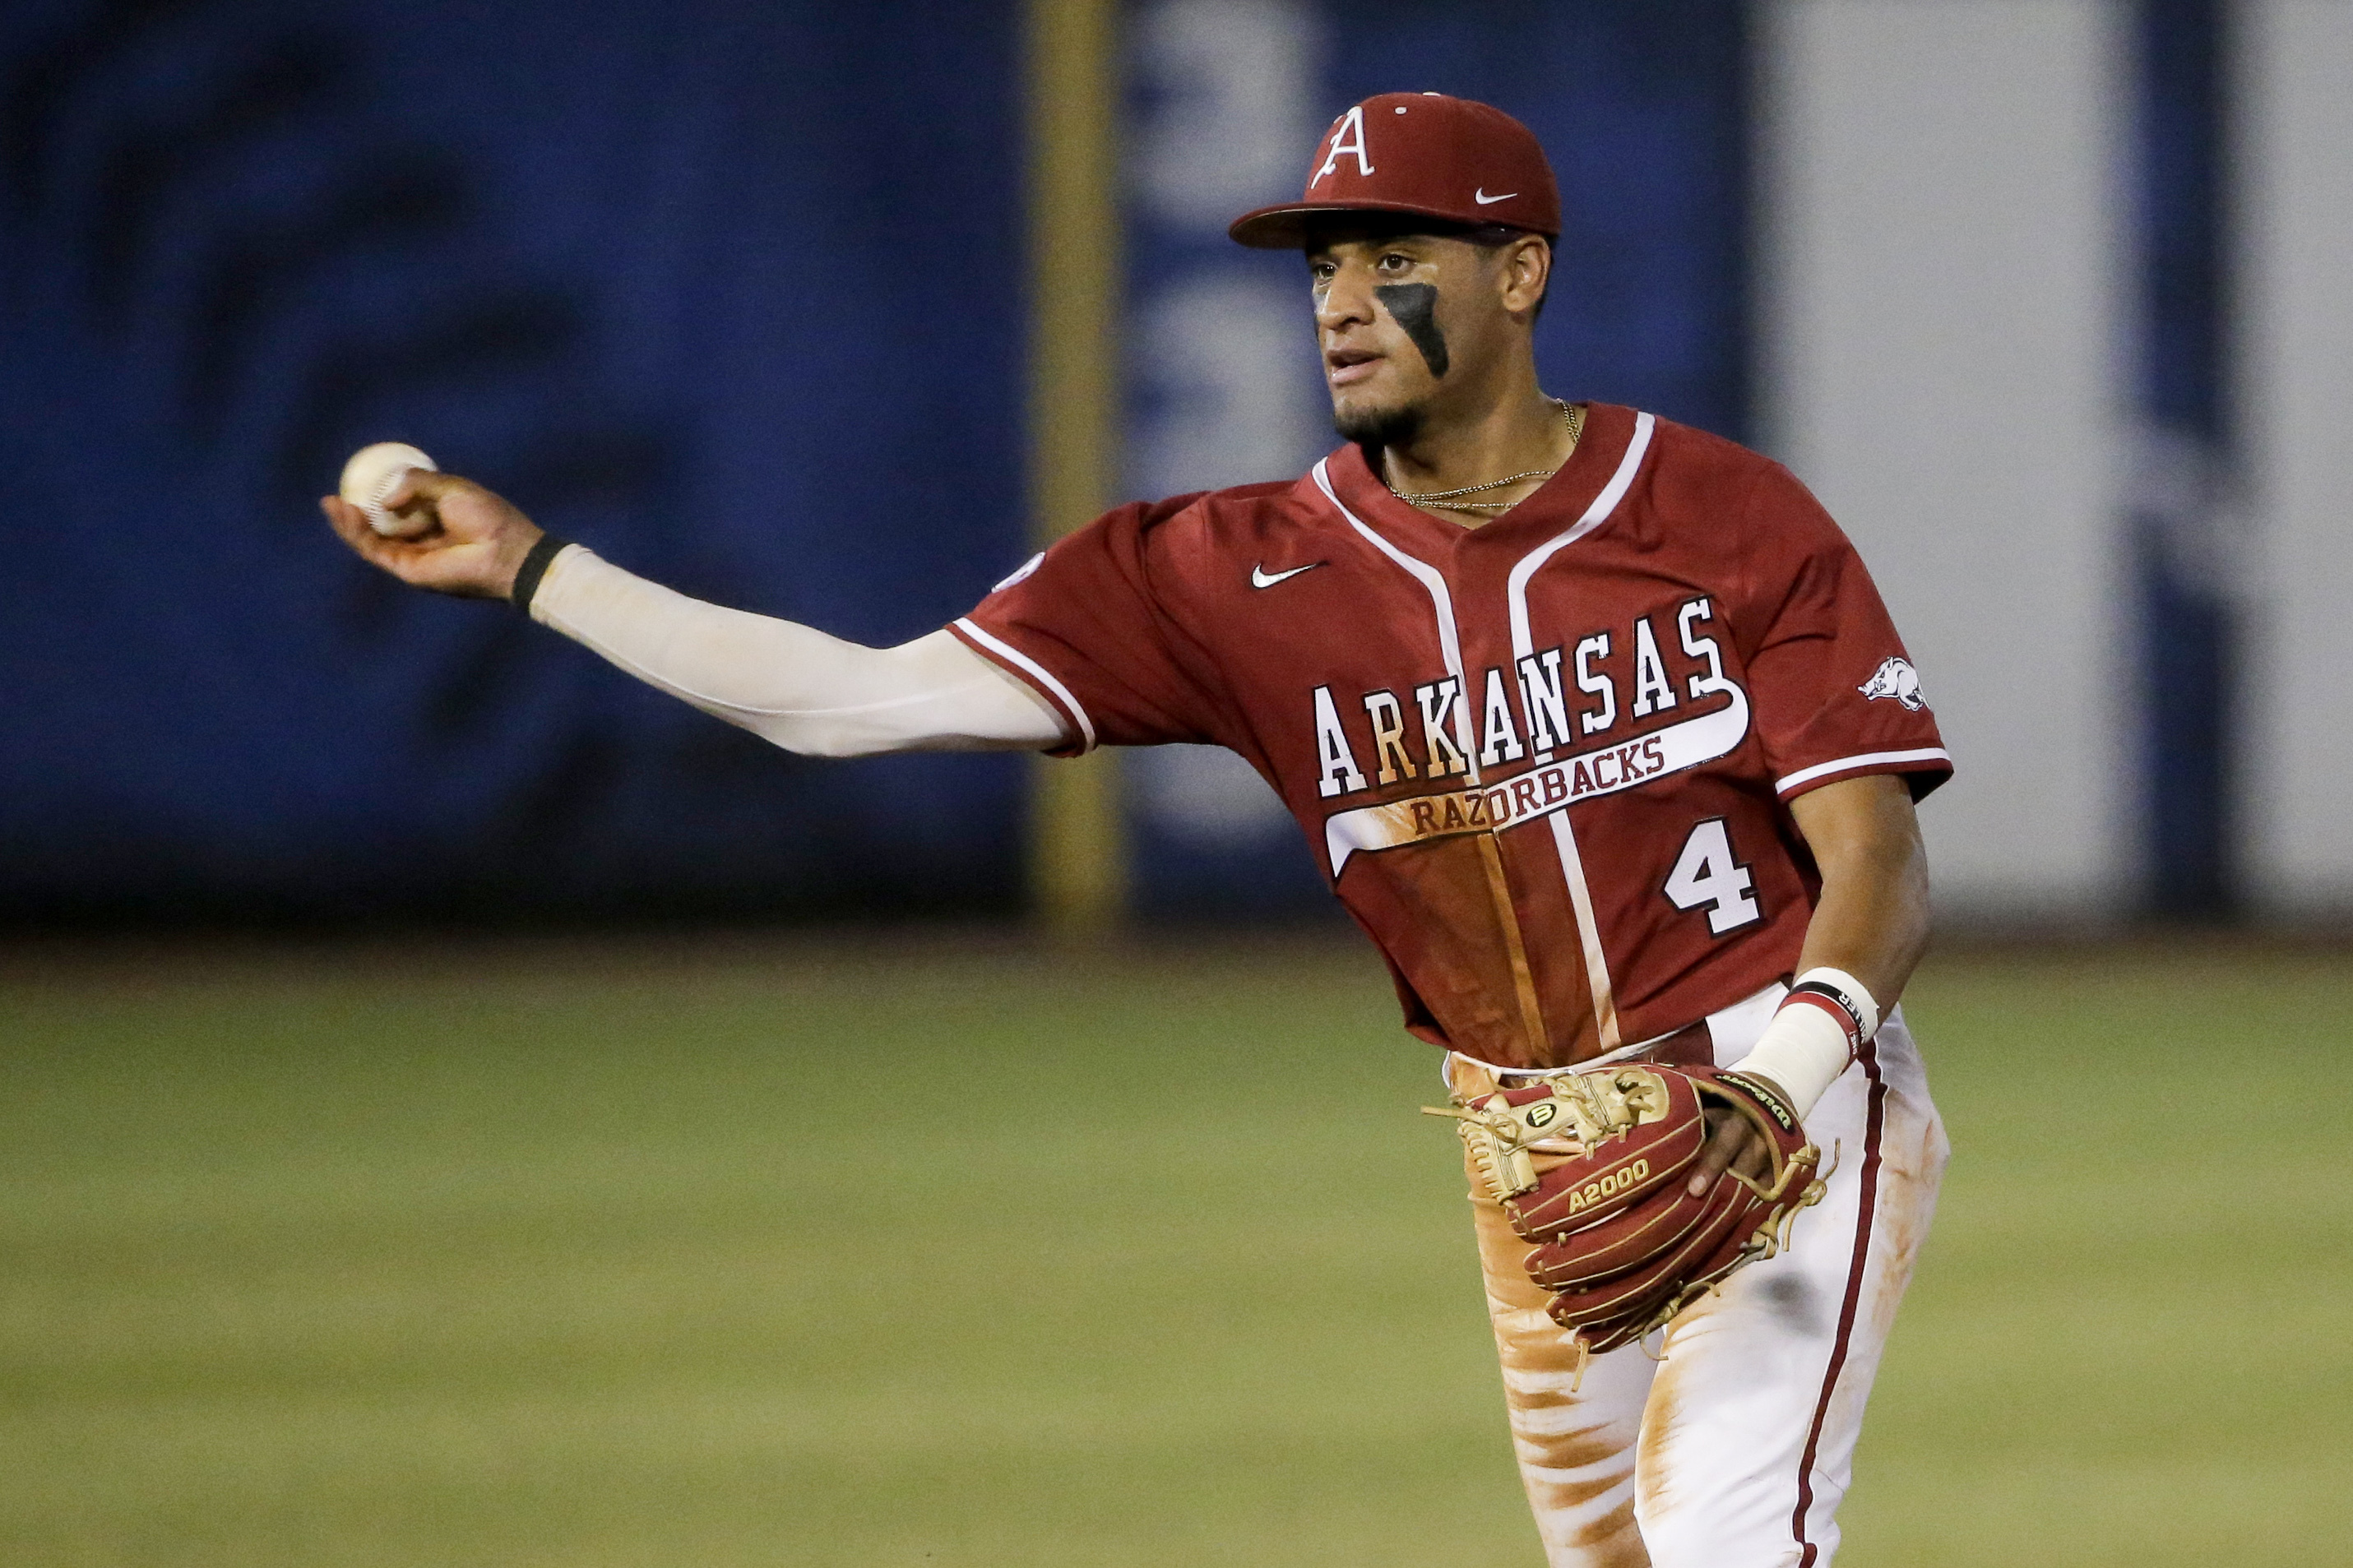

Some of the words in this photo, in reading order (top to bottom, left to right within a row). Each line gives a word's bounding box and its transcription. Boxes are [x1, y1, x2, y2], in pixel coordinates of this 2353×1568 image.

[1310, 105, 1375, 189] A
[1313, 596, 1725, 799] ARKANSAS
[1410, 735, 1665, 836] RAZORBACKS
[1663, 818, 1762, 937] 4
[1568, 1159, 1650, 1214] A2000
